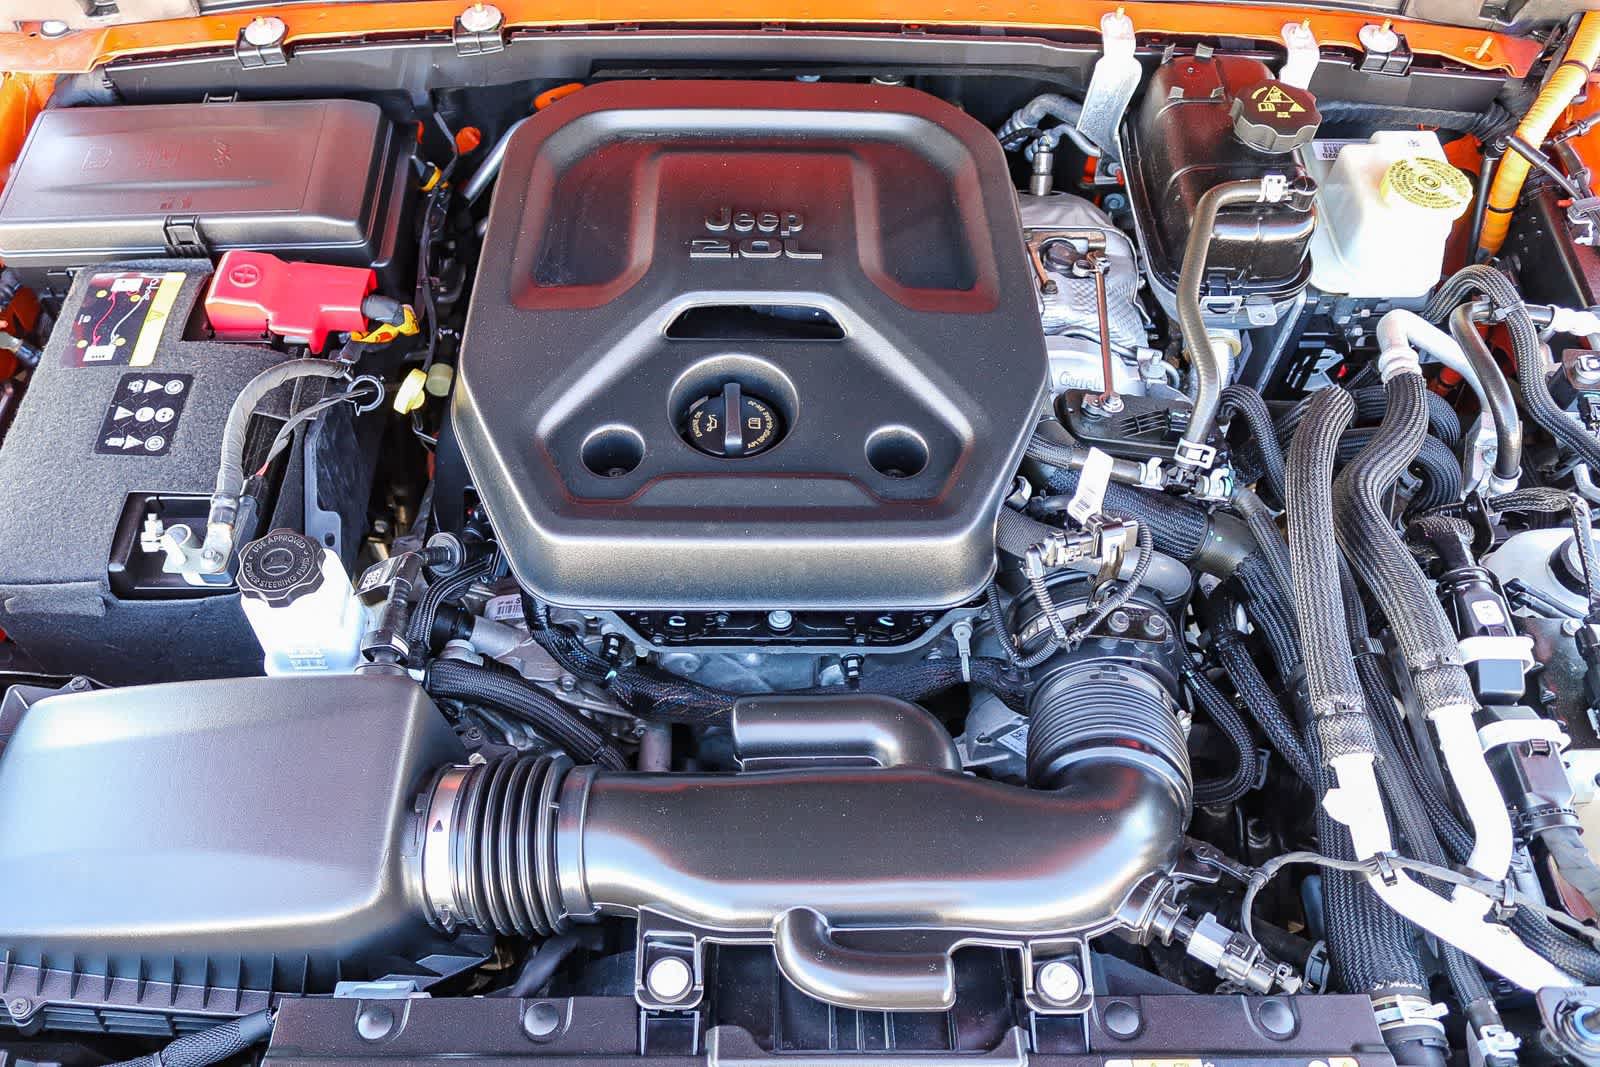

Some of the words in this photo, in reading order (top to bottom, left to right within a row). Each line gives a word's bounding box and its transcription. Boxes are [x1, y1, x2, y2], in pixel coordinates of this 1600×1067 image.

[704, 207, 804, 237] Jeep
[690, 240, 823, 259] 2.0L
[251, 540, 266, 553] USE
[268, 534, 305, 549] APPROVED
[245, 562, 260, 584] POWER
[259, 576, 297, 589] STEERING
[296, 557, 310, 576] FLUID
